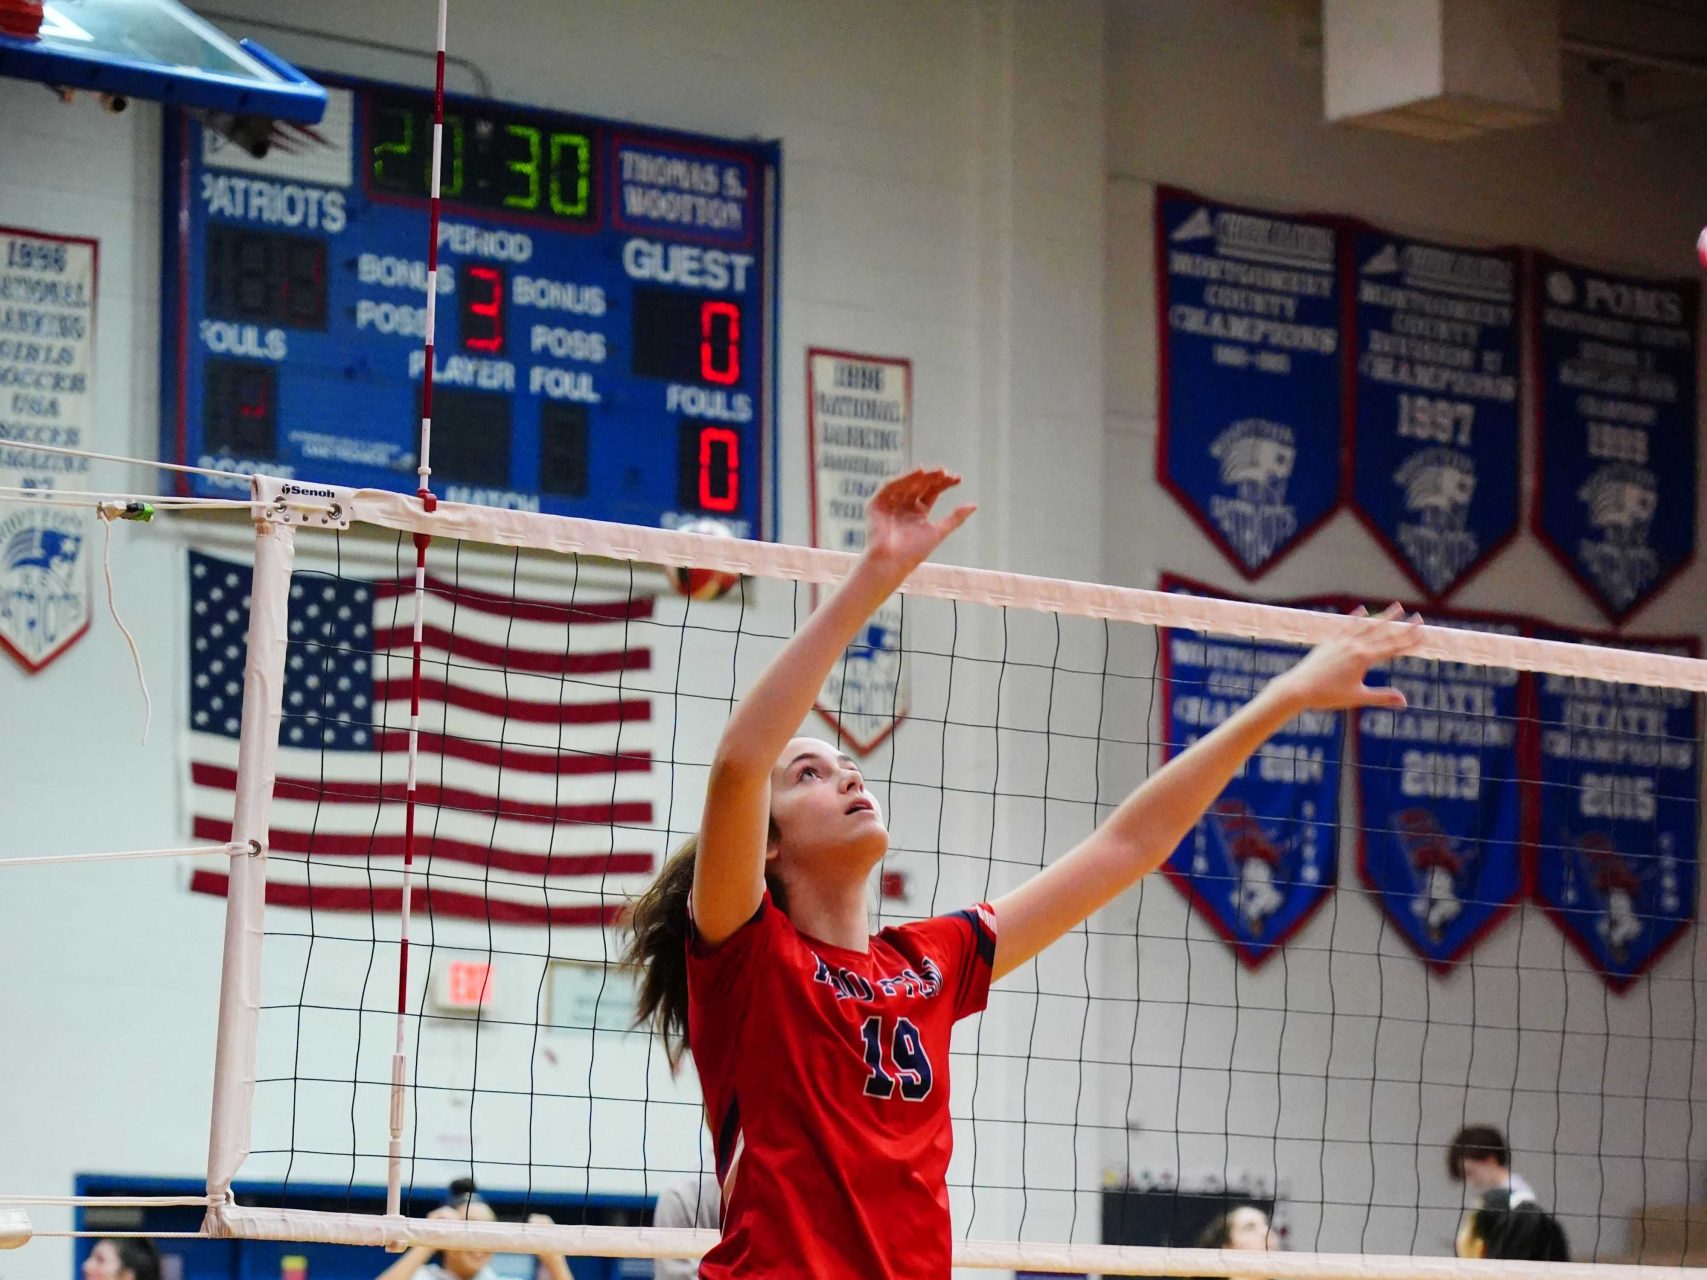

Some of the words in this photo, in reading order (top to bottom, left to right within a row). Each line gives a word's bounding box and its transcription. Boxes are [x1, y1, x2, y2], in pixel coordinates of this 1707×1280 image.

[622, 237, 754, 293] GUEST
[465, 266, 503, 350] 3
[512, 275, 607, 317] BONUS
[531, 325, 606, 363] POSS
[701, 302, 740, 386] 0
[409, 350, 515, 391] PLAYER
[530, 366, 601, 403] FOUL
[667, 384, 752, 422] FOULS
[699, 427, 739, 512] 0
[291, 486, 335, 498] Senoh
[861, 1016, 933, 1102] 19
